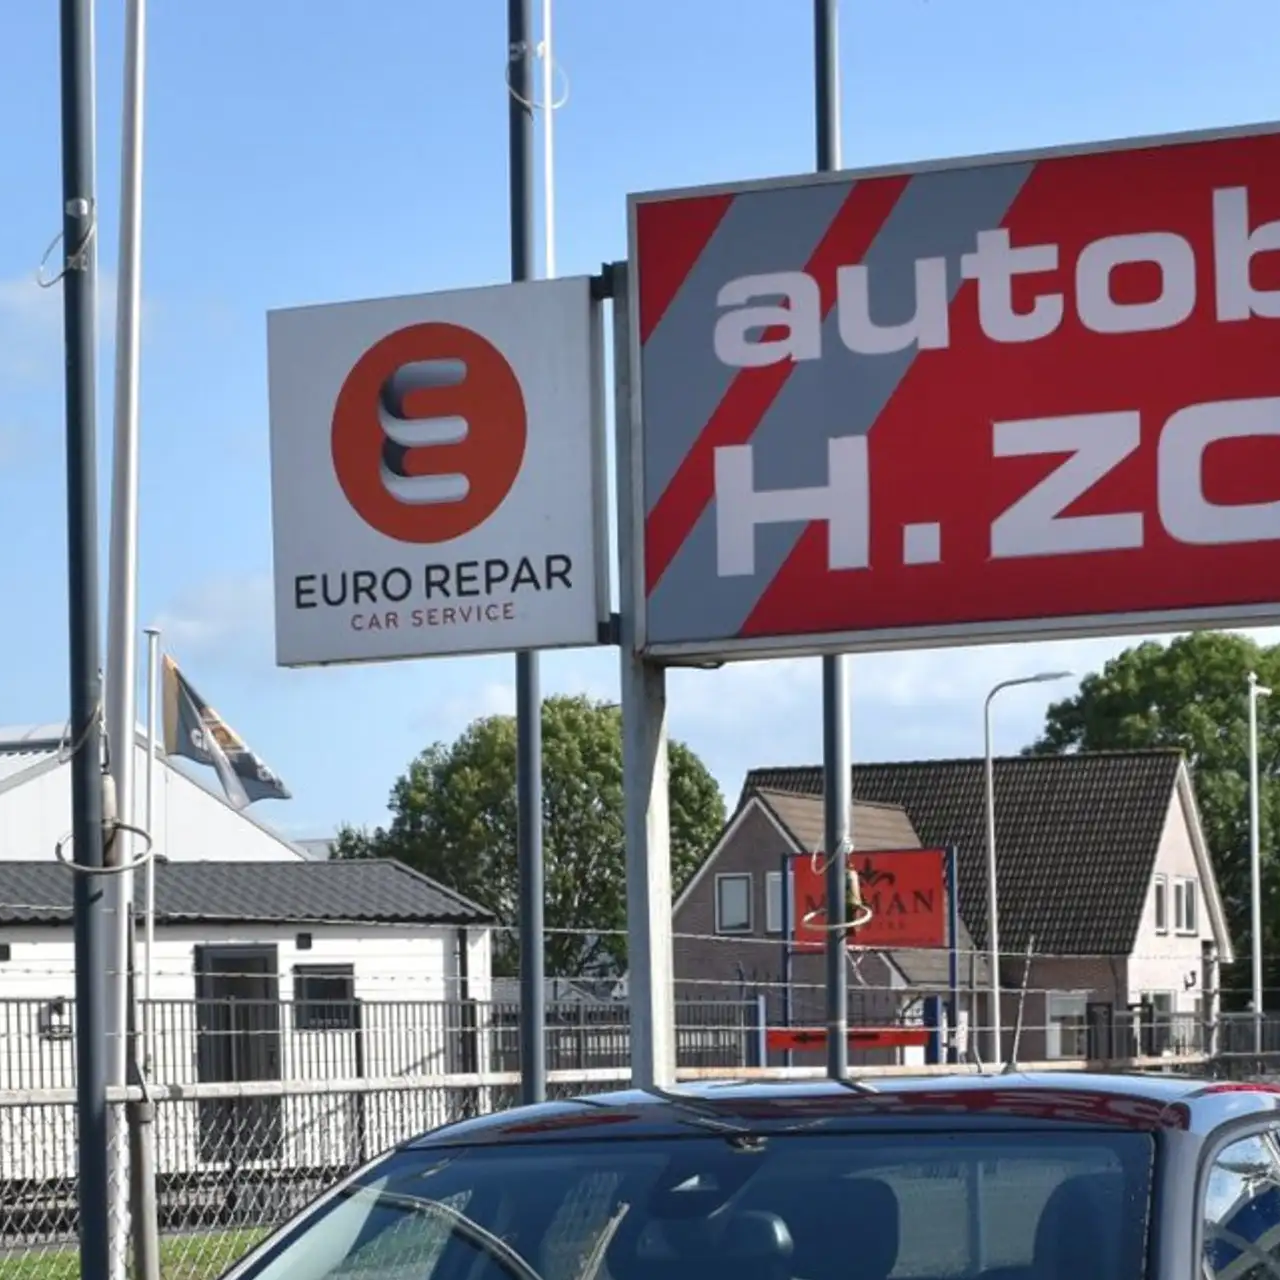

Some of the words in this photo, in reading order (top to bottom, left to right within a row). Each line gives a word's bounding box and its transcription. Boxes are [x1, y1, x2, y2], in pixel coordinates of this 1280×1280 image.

[713, 433, 942, 578] H.
[294, 566, 412, 610] EURO
[425, 553, 573, 601] REPAR
[351, 609, 400, 631] CAR
[412, 602, 516, 628] SERVICE
